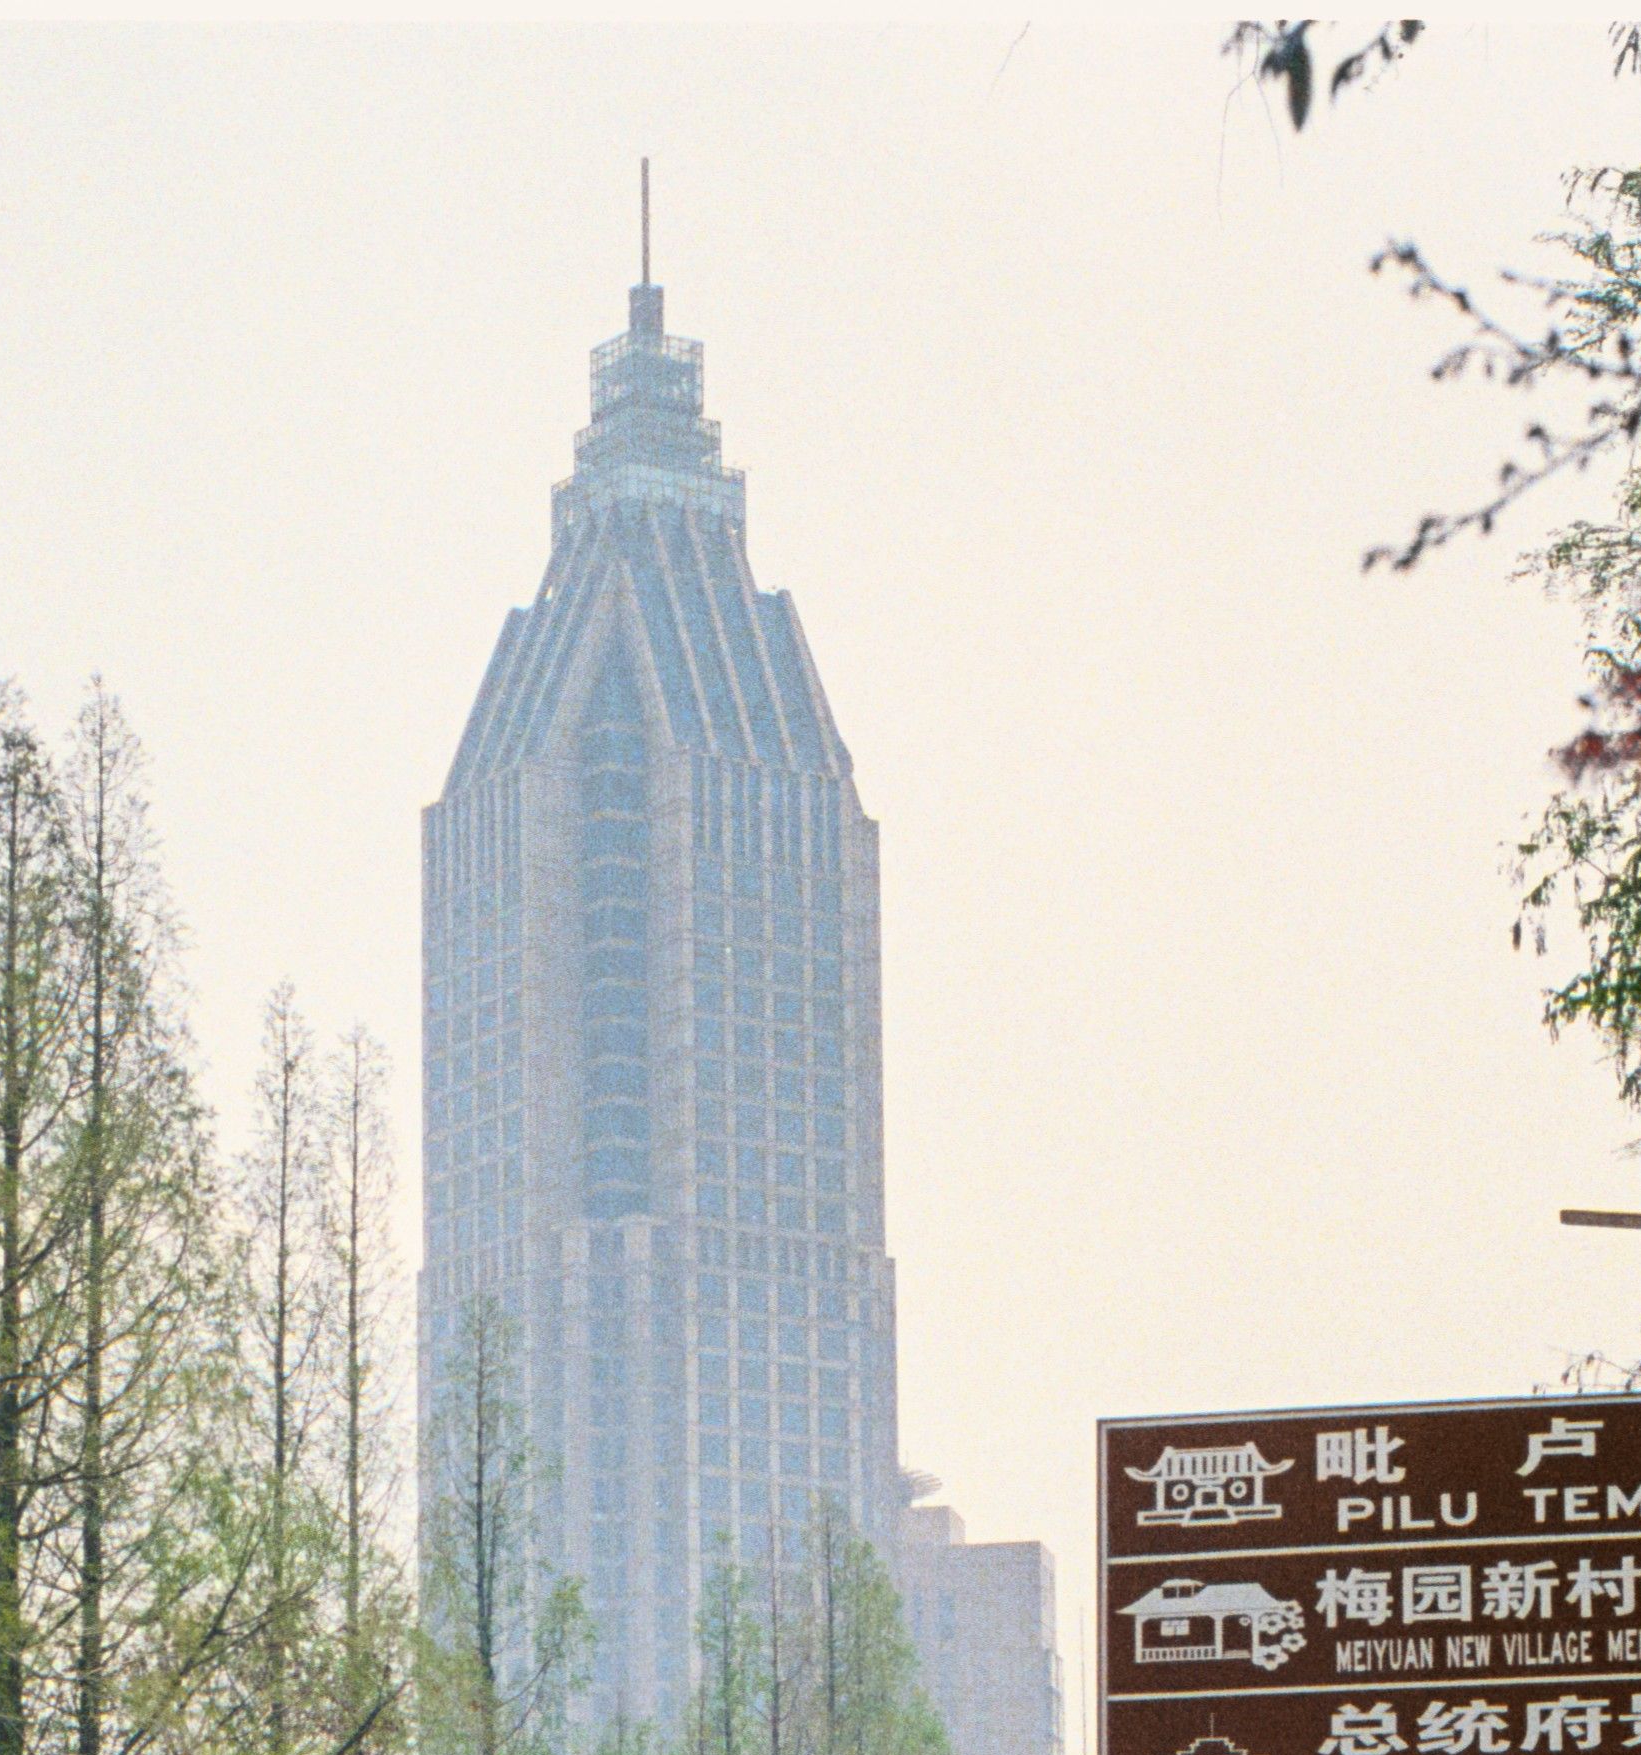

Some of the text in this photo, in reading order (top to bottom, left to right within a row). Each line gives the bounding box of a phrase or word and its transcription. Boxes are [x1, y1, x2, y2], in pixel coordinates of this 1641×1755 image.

[1337, 1491, 1477, 1532] PILU
[1336, 1637, 1434, 1673] MEIYUAN
[1446, 1635, 1492, 1668] NEW
[1503, 1629, 1593, 1666] VILLAGE
